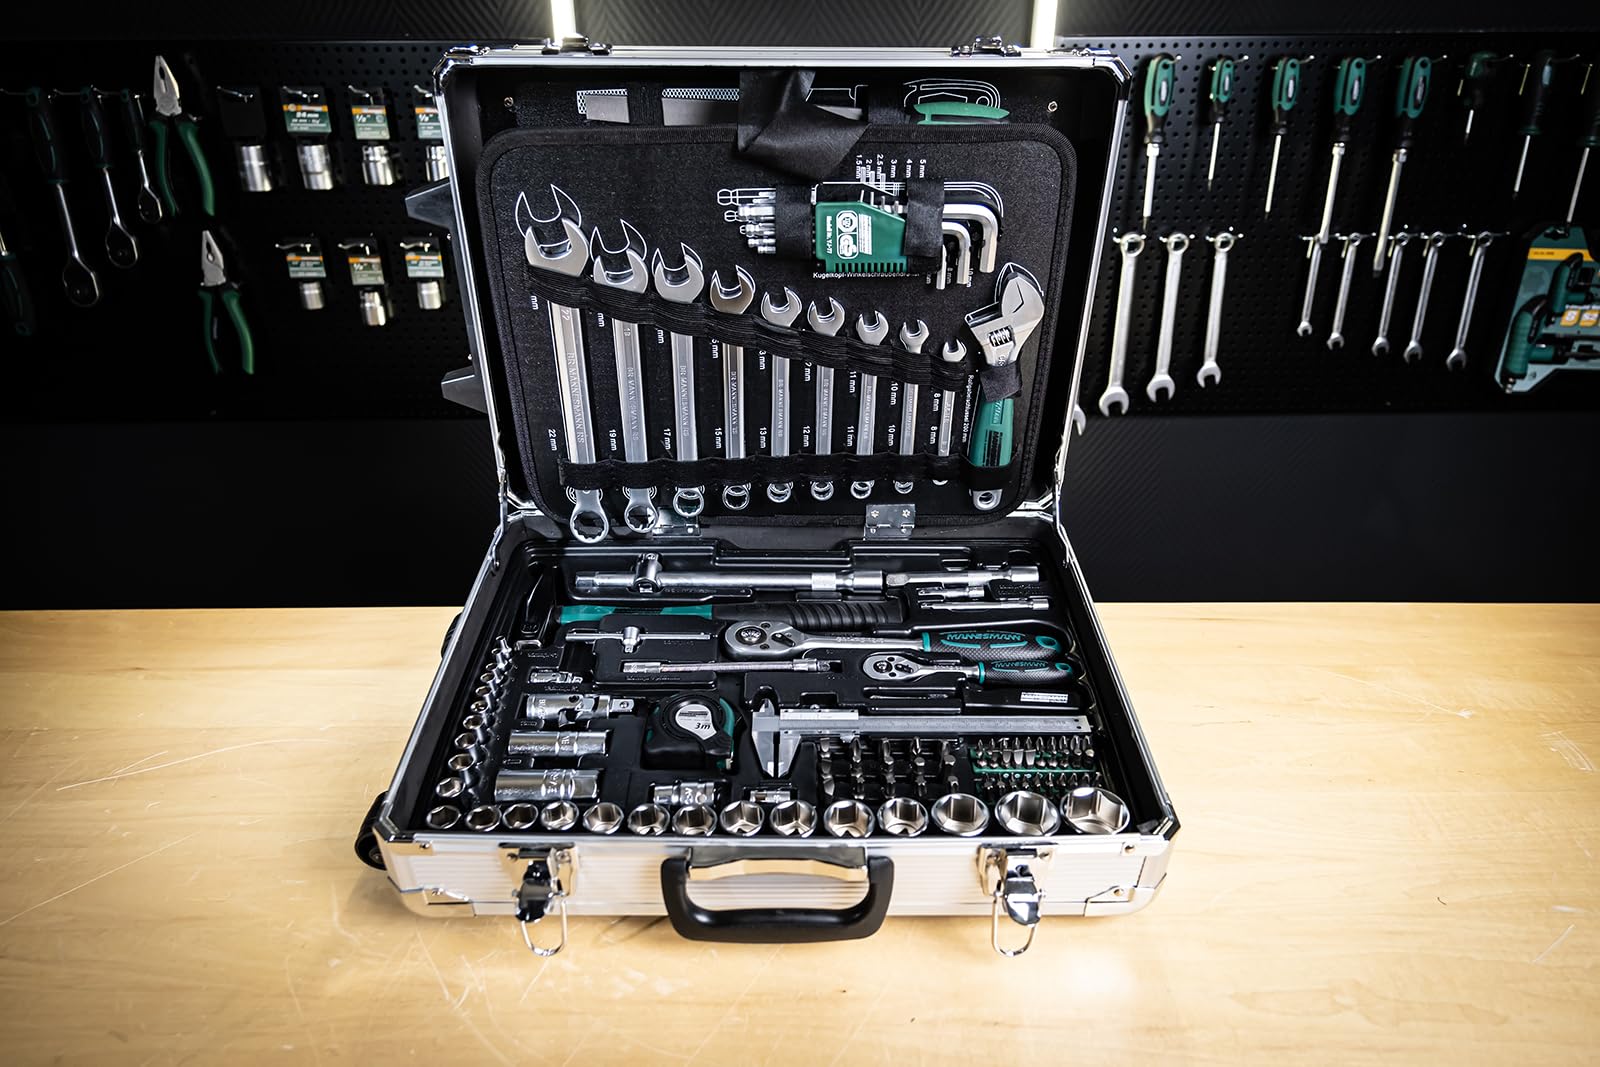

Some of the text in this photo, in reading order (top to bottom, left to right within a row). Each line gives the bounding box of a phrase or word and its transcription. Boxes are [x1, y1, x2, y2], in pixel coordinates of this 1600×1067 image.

[890, 382, 898, 391] 10
[568, 367, 584, 429] MANNESMANN
[548, 428, 557, 450] 22 mm
[609, 429, 617, 450] 19 mm
[663, 428, 671, 450] 17 mm
[714, 428, 722, 449] 15 mm
[760, 427, 767, 448] 13 mm
[803, 426, 810, 447] 12 mm
[847, 426, 854, 446] 11 mm
[888, 425, 896, 446] 10 mm
[930, 433, 936, 444] mm
[946, 633, 1021, 641] MANNESMANN
